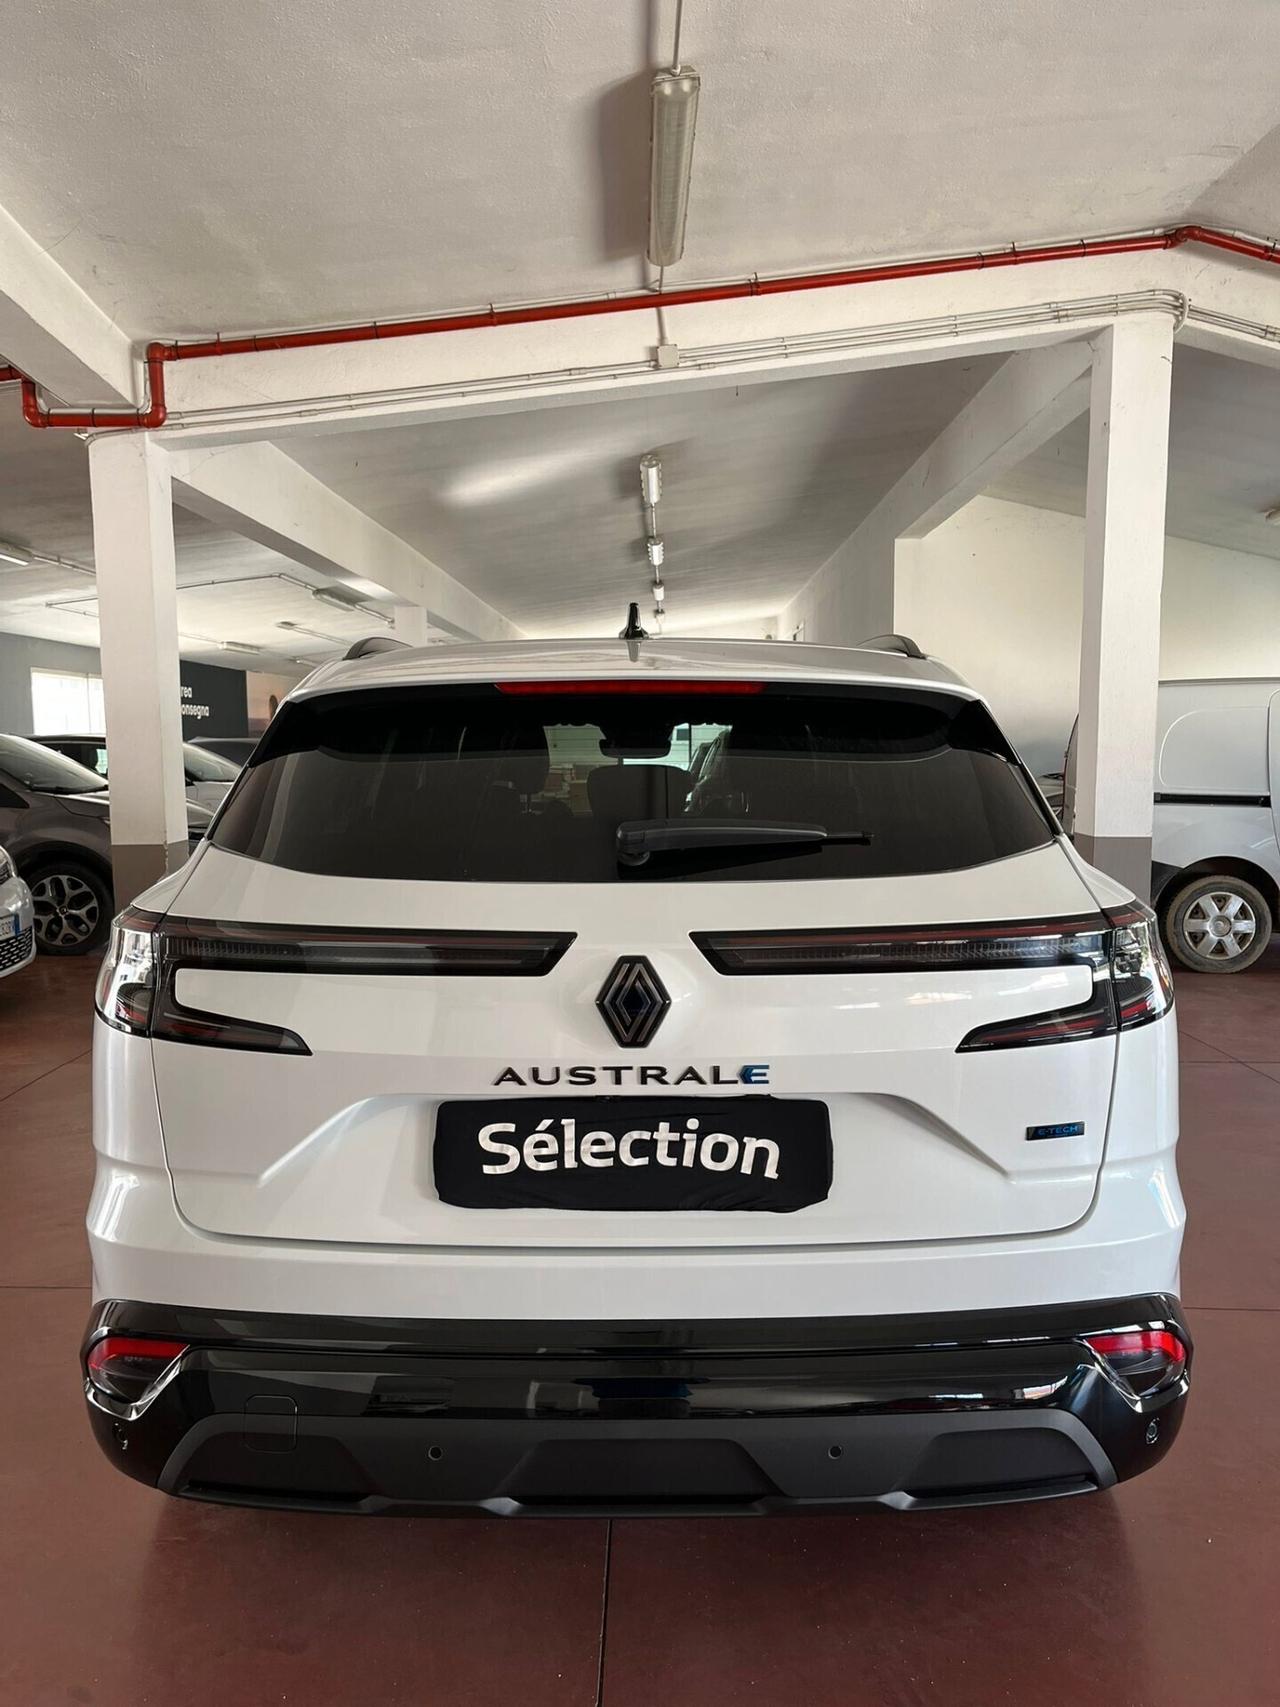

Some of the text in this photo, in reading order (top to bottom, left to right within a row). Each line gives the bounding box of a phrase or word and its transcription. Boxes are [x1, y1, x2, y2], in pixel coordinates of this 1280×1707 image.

[180, 686, 193, 698] rea
[181, 704, 210, 719] onsegna
[494, 1065, 770, 1087] AUSTRALE
[1038, 1125, 1077, 1135] E-TECH
[478, 1117, 781, 1180] Sélection
